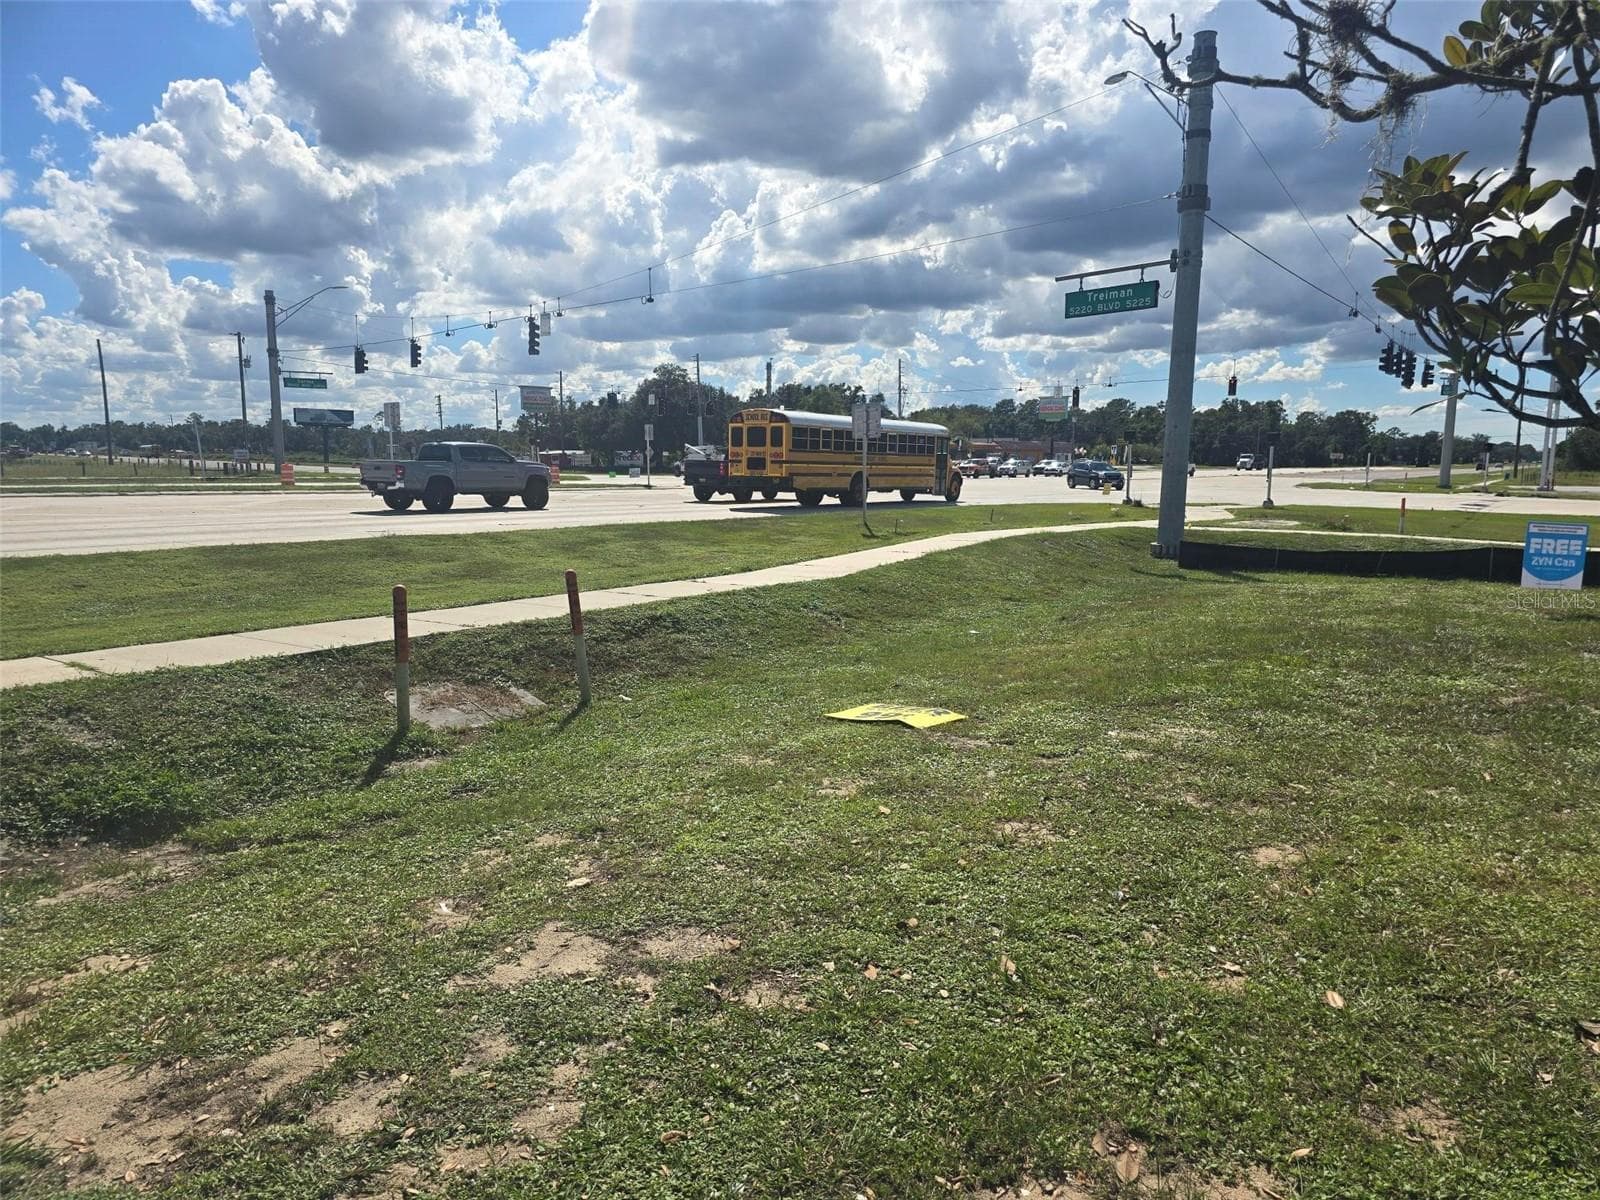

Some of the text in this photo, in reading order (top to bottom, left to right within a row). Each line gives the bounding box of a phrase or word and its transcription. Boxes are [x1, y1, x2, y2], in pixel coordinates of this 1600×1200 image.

[1087, 288, 1133, 302] Treiman
[1069, 297, 1151, 315] 5220 BLVD 5225
[1529, 538, 1583, 556] FREE
[1531, 556, 1576, 567] ZYN Can
